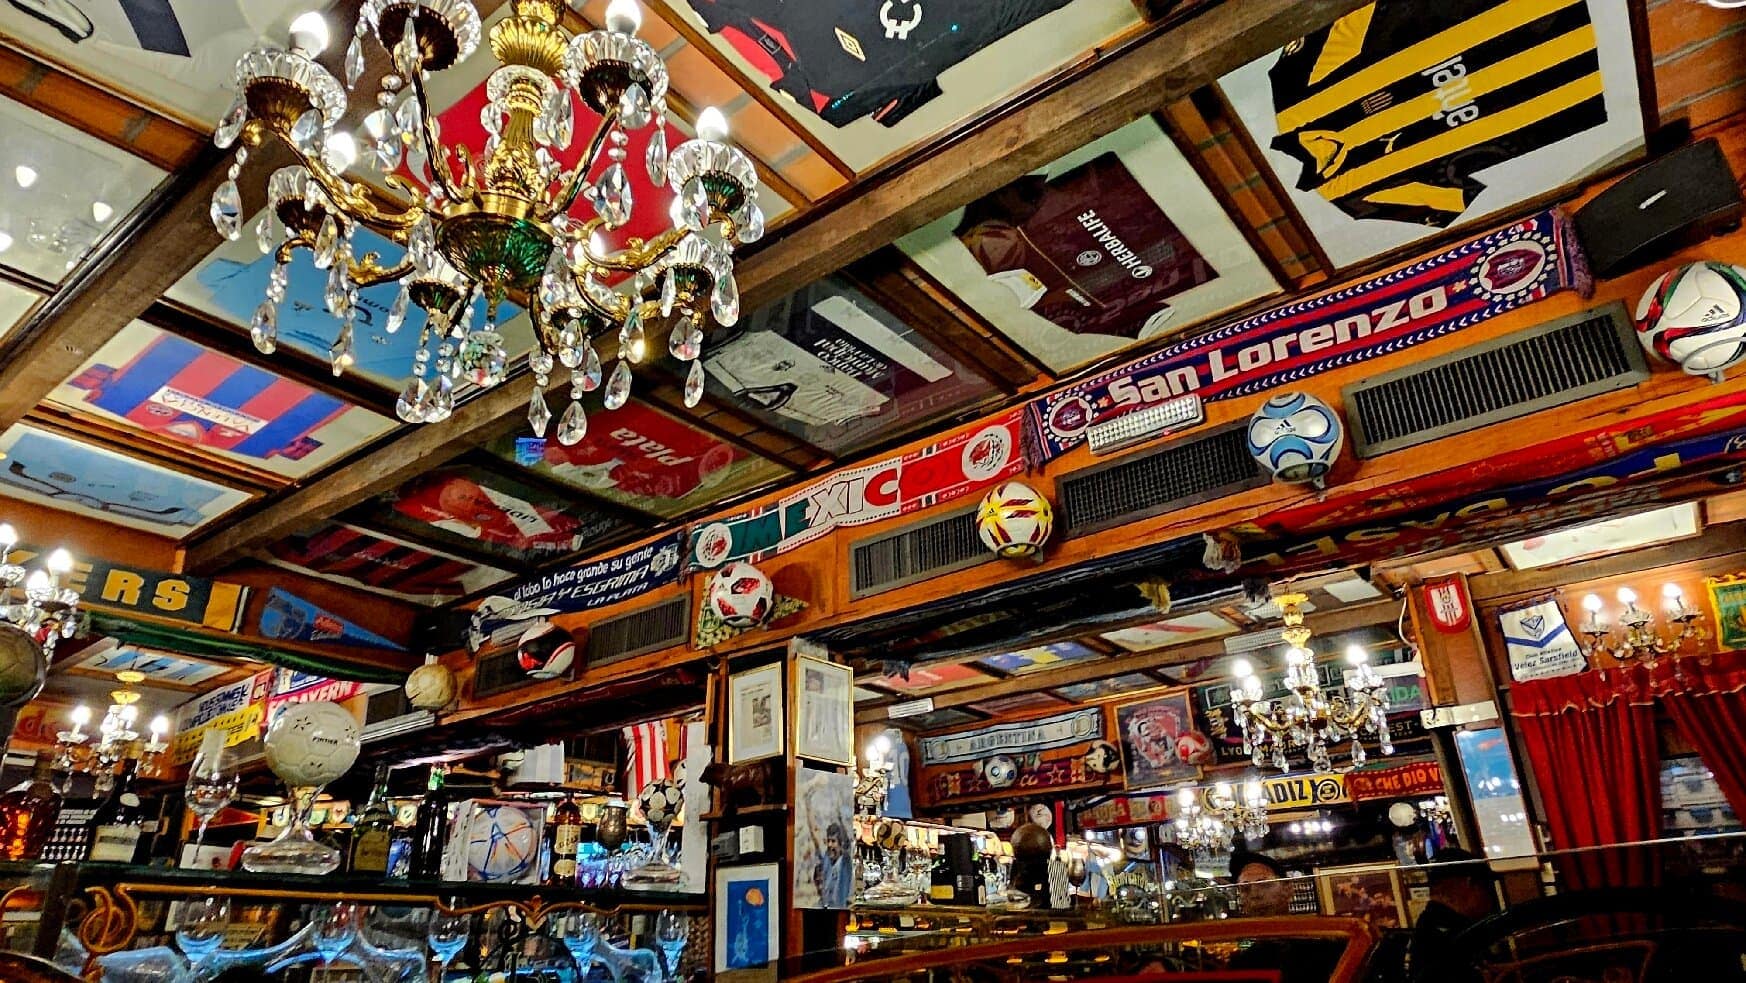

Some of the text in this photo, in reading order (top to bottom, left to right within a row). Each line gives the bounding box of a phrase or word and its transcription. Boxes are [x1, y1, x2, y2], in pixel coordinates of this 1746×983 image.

[1421, 55, 1480, 128] antel
[1077, 208, 1139, 272] HERBALIFE
[1107, 287, 1447, 406] San Lorenzo
[610, 427, 694, 466] Plata
[554, 570, 575, 585] hace
[577, 563, 609, 583] grande
[611, 559, 623, 571] su
[625, 547, 653, 569] gente
[571, 565, 649, 598] ESGRIMA
[605, 582, 649, 602] PLATA
[969, 727, 1046, 751] ARGENTINA
[1375, 774, 1401, 791] CHE
[1402, 770, 1424, 787] DIO
